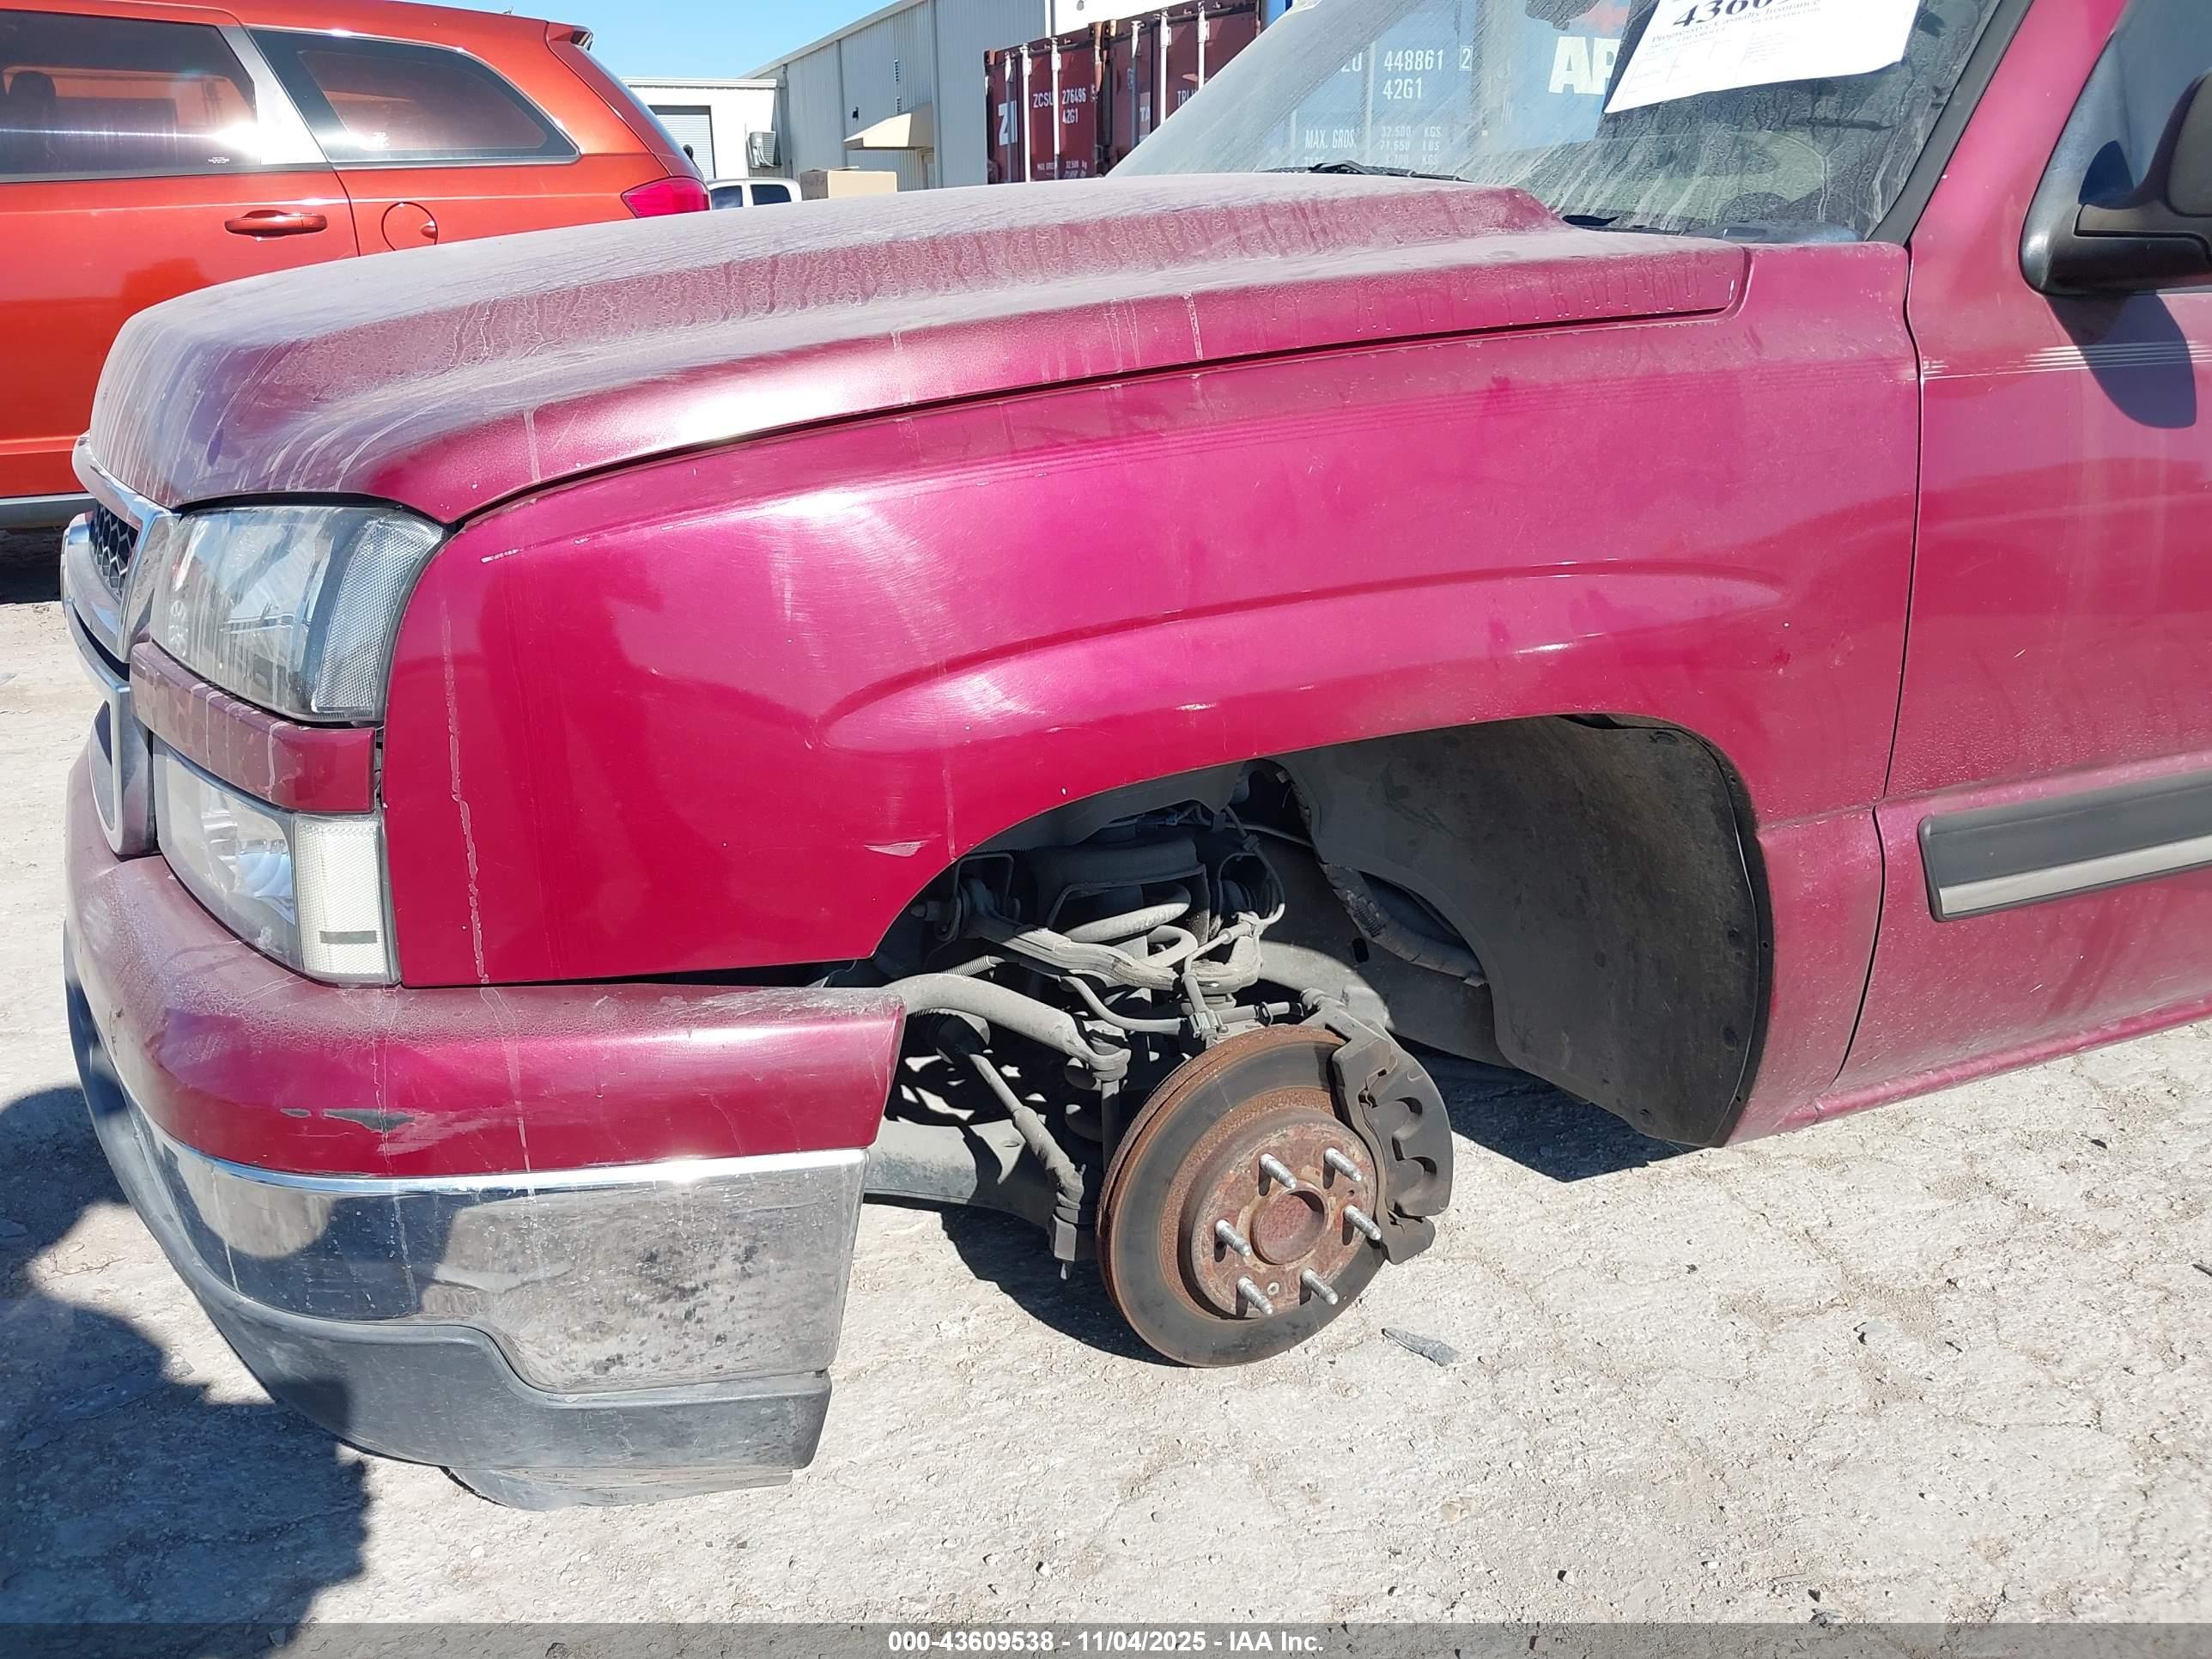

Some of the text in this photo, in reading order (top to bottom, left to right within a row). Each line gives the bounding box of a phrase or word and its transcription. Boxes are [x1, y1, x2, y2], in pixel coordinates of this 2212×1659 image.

[1384, 49, 1443, 71] 448861
[1461, 47, 1472, 70] 2
[1382, 77, 1422, 100] 42G1
[1304, 130, 1328, 149] MAX.
[1423, 125, 1442, 138] KGS
